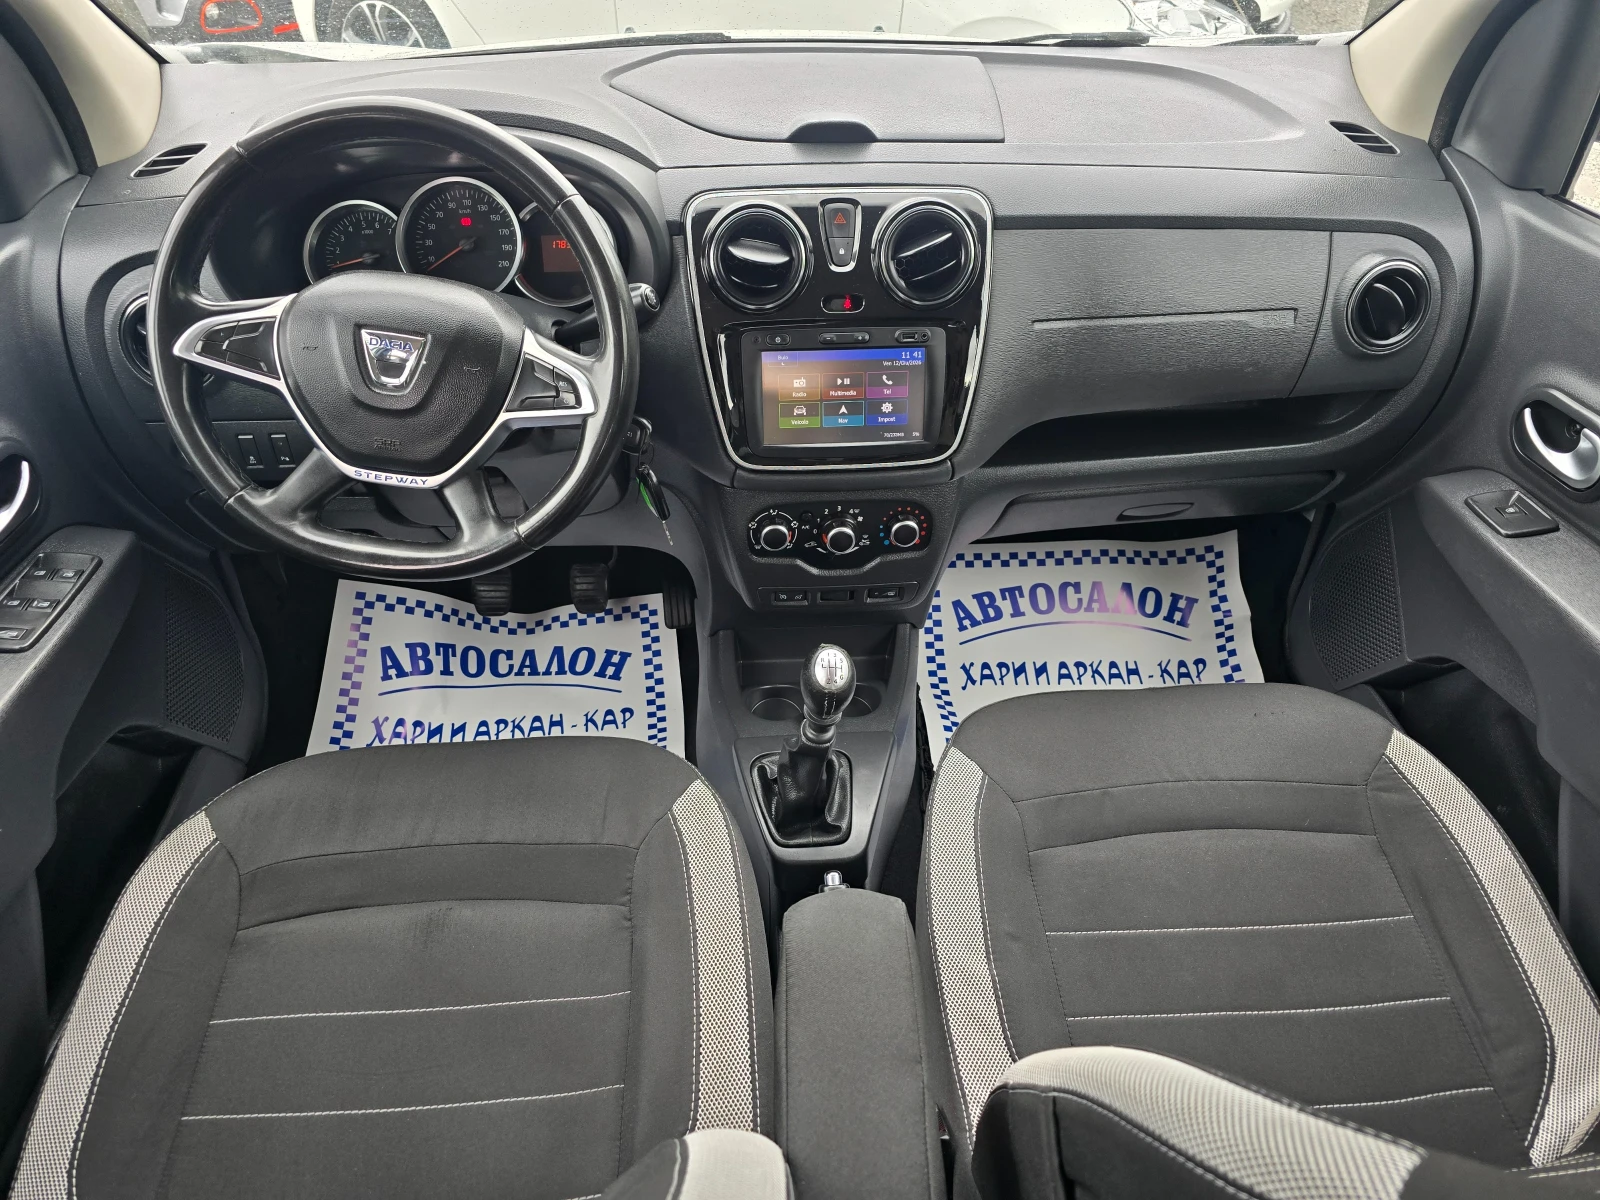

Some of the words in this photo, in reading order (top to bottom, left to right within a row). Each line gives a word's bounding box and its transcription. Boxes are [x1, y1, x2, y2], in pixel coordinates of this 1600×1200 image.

[369, 336, 413, 352] DACIA
[354, 469, 429, 486] STEPWAY
[951, 581, 1199, 633] АВТОСАЛОН
[380, 642, 632, 682] АВТОСАЛОН
[959, 661, 1030, 691] ХАРИ
[1057, 659, 1144, 687] АРКАН
[1157, 657, 1208, 684] КАР
[473, 713, 564, 742] АРКАН
[583, 707, 635, 733] КАР
